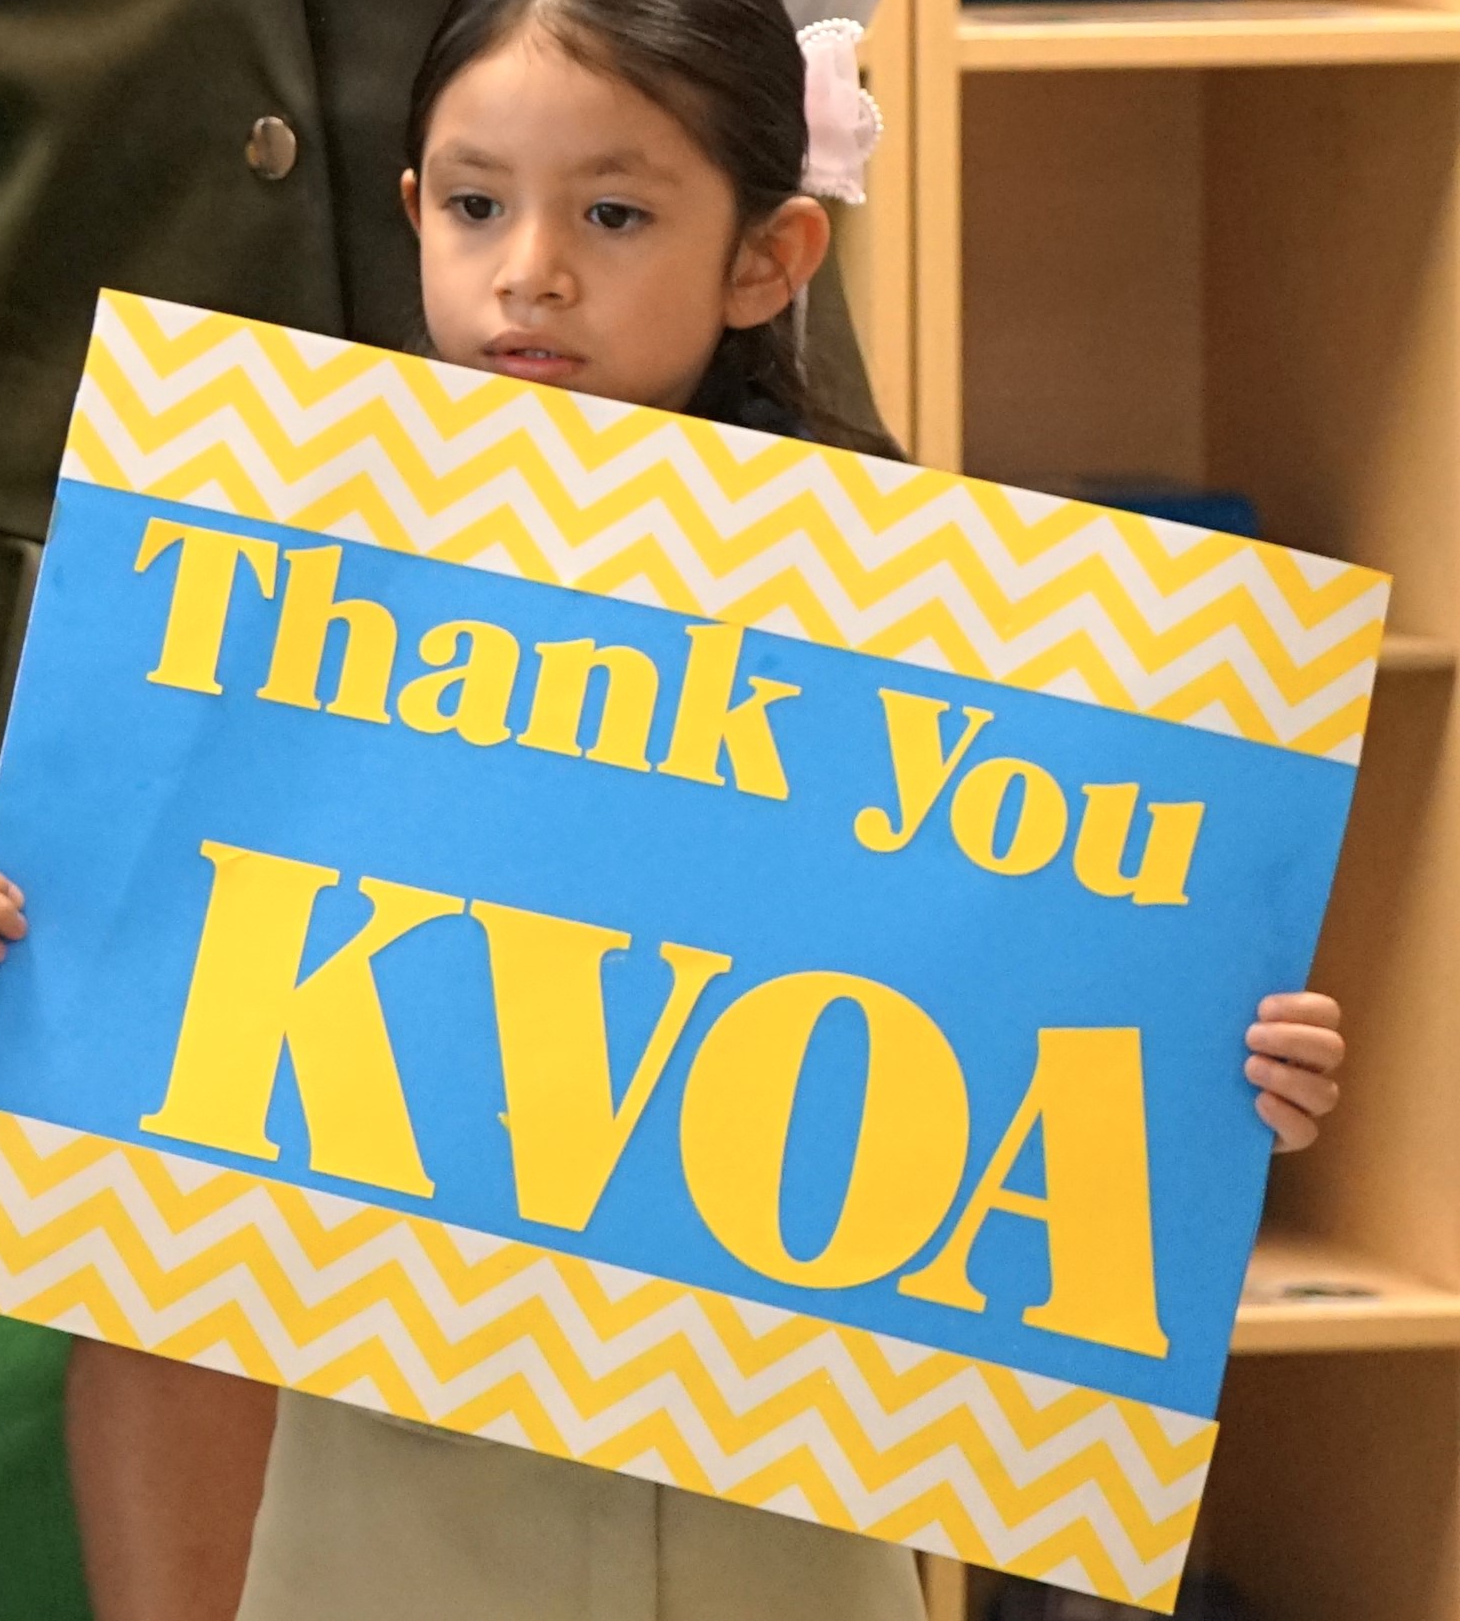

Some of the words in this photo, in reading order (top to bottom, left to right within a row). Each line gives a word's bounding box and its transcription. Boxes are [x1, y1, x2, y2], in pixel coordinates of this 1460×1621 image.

[134, 516, 804, 803] Thank
[852, 687, 1207, 908] you
[137, 837, 1173, 1361] KVOA
